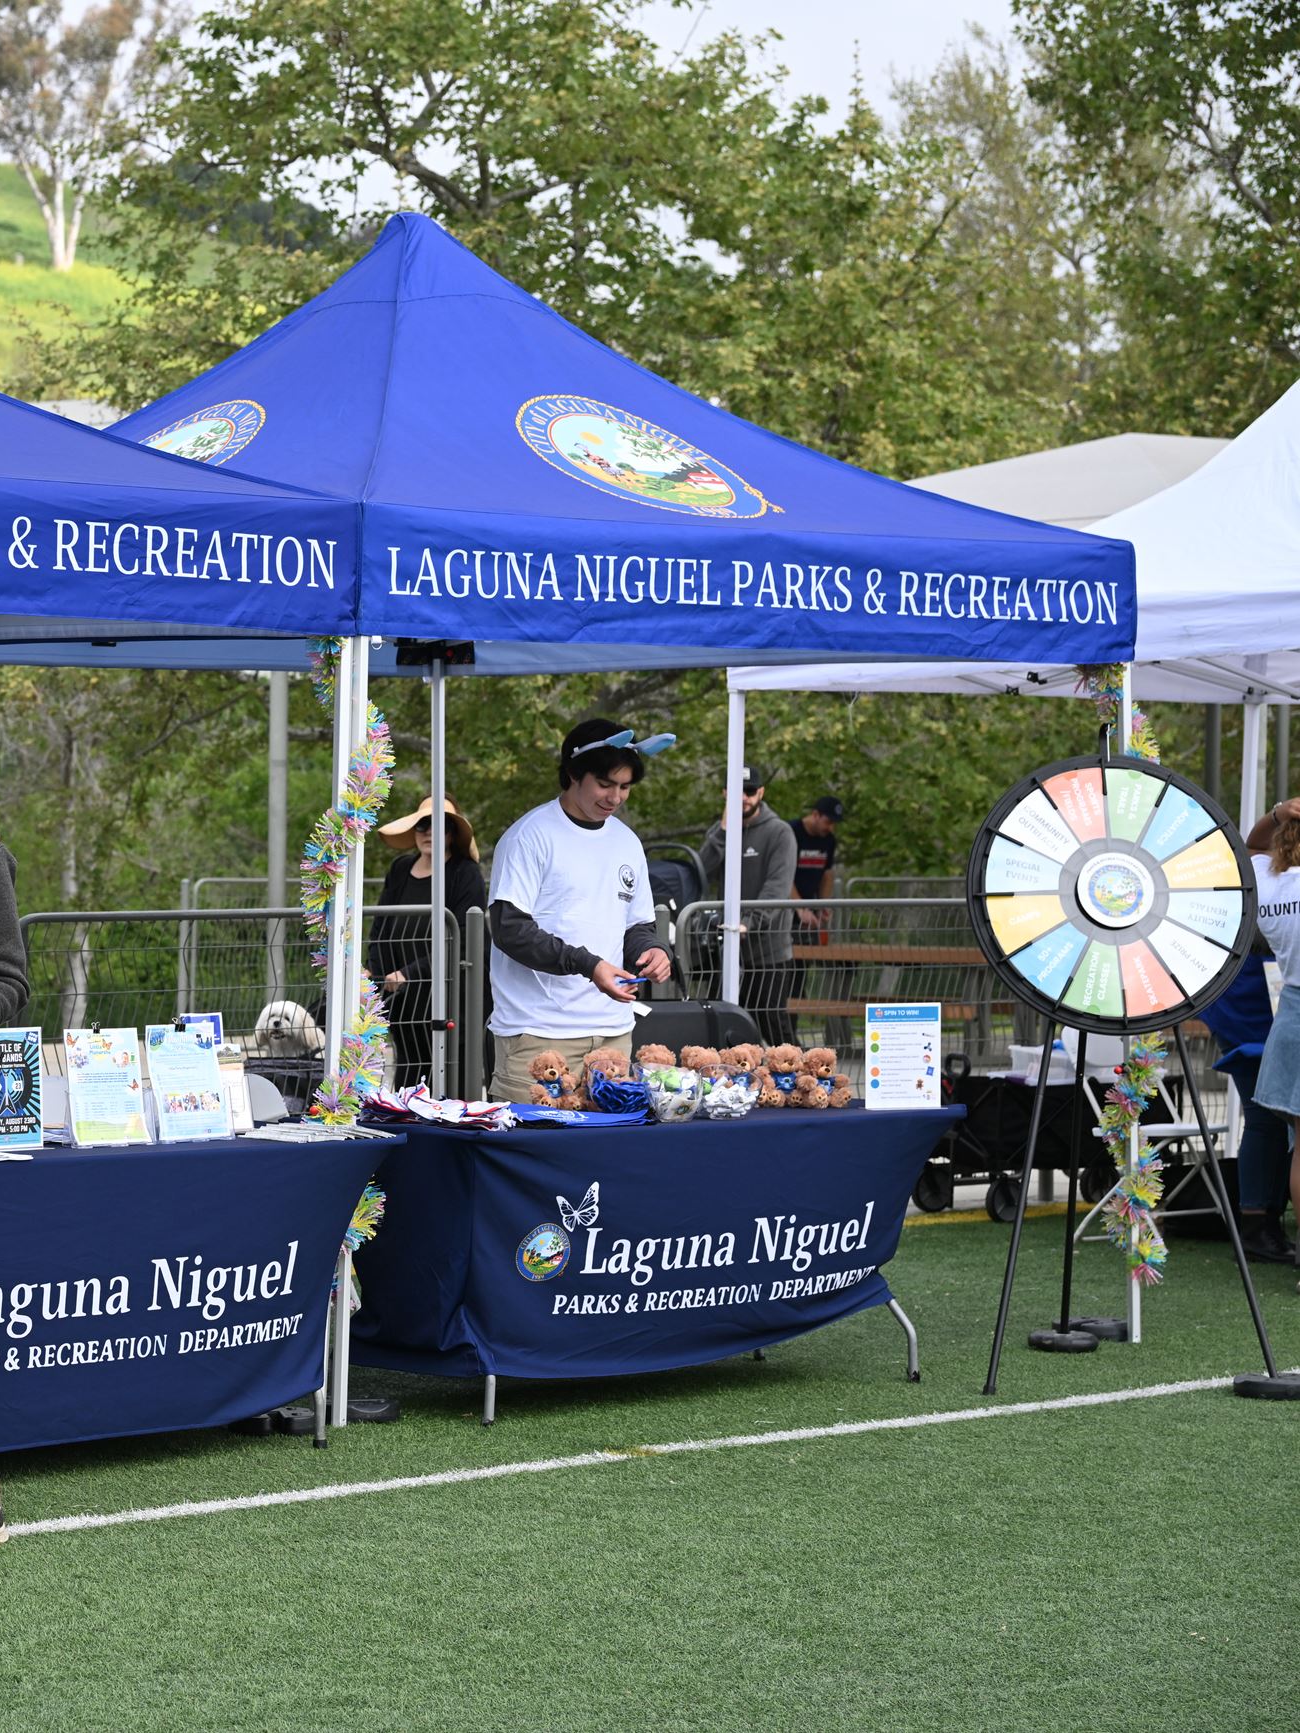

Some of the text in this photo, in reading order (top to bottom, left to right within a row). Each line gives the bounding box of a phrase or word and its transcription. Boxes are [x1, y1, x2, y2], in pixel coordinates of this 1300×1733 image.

[536, 398, 617, 422] LAGUNA
[623, 414, 709, 466] NIGUEL
[7, 514, 39, 570] &
[53, 518, 338, 590] RECREATION
[387, 546, 1119, 626] LAGUNA NIGUEL PARKS & RECREATION
[1071, 778, 1092, 826] PROGRAMS
[1085, 782, 1101, 816] SPORTS
[1117, 787, 1129, 815] TRAILS
[1131, 783, 1142, 810] PARKS
[1024, 805, 1070, 844] COMMUNITY
[1156, 809, 1189, 846] AQUATICS
[1005, 858, 1041, 872] SPECIAL
[1005, 870, 1039, 884] EVENTS
[1187, 913, 1226, 928] FACILITY
[1189, 901, 1228, 917] RENTALS
[1259, 900, 1300, 919] OLUNT
[1036, 942, 1074, 982] PROGRAMS
[1171, 939, 1208, 972] ANY PRIZE
[1082, 951, 1100, 1006] RECREATION
[1097, 962, 1111, 1000] CLASSES
[1132, 956, 1158, 1005] SKATEPARK
[14, 1043, 22, 1052] OF
[579, 1201, 875, 1287] Laguna Niguel
[147, 1240, 300, 1321] Niguel
[552, 1265, 876, 1315] PARKS & RECREATION DEPARTMENT
[4, 1350, 21, 1372] &
[27, 1334, 167, 1369] RECREATION
[178, 1313, 304, 1354] DEPARTMENT
